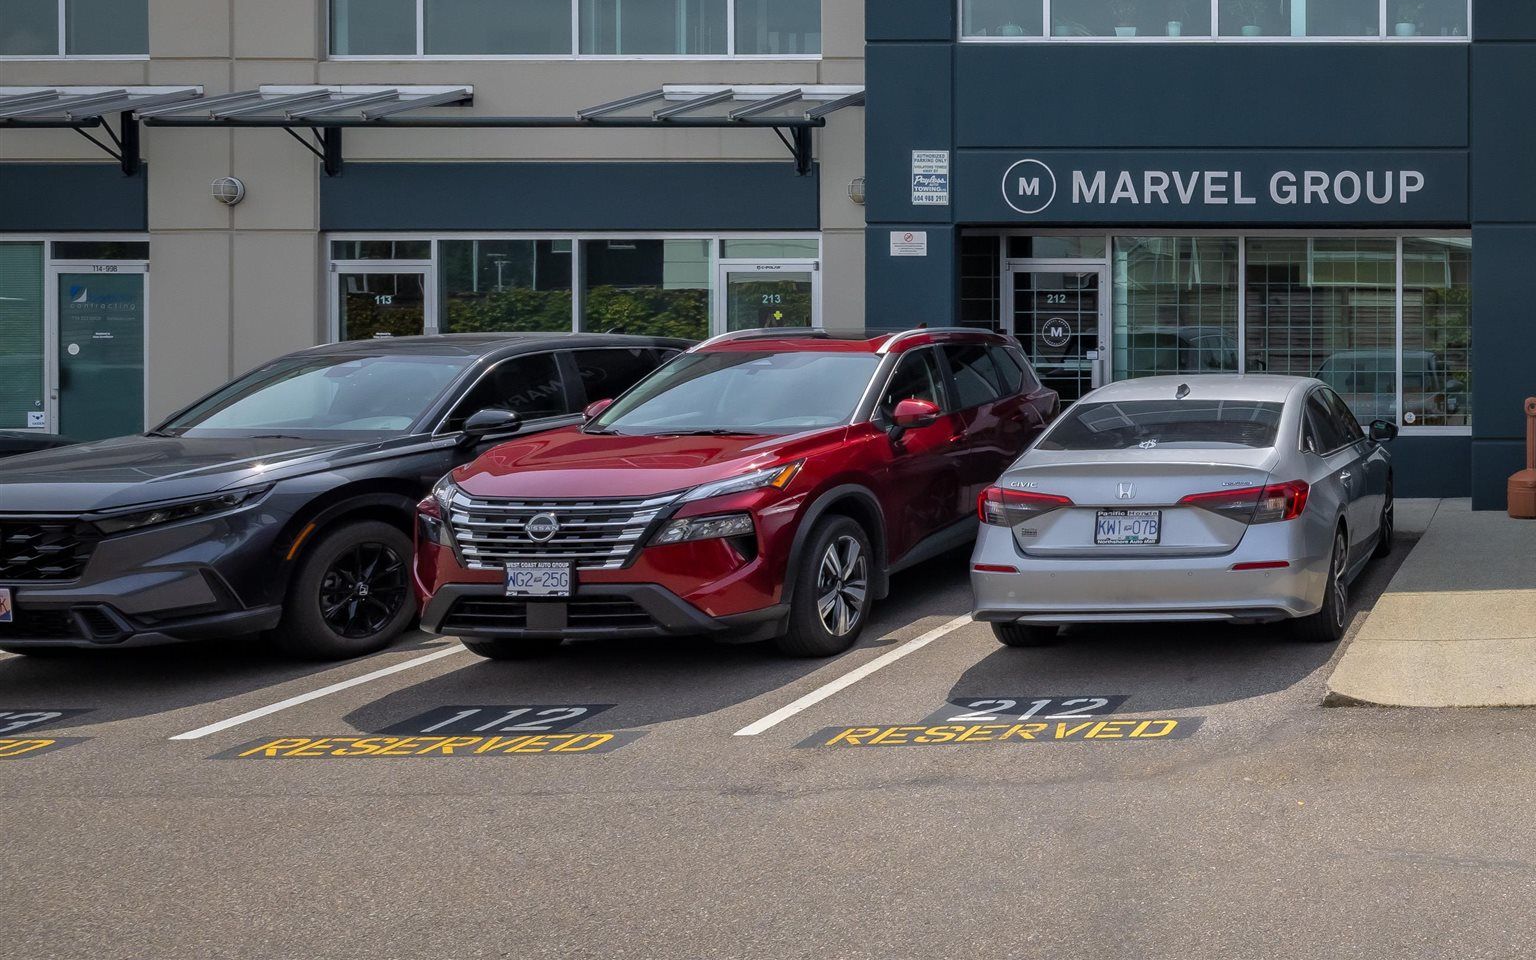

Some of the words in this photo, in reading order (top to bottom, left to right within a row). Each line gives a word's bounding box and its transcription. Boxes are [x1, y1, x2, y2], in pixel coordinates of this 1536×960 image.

[1018, 177, 1040, 196] M
[1071, 170, 1257, 204] MARVEL
[1269, 170, 1425, 204] GROUP
[374, 295, 392, 305] 113
[762, 294, 781, 304] 213
[1046, 294, 1066, 304] 212
[1050, 326, 1063, 337] M
[420, 707, 588, 733] 112
[947, 698, 1109, 722] 212
[825, 719, 1179, 746] RESERVED
[238, 733, 615, 758] RESERVED
